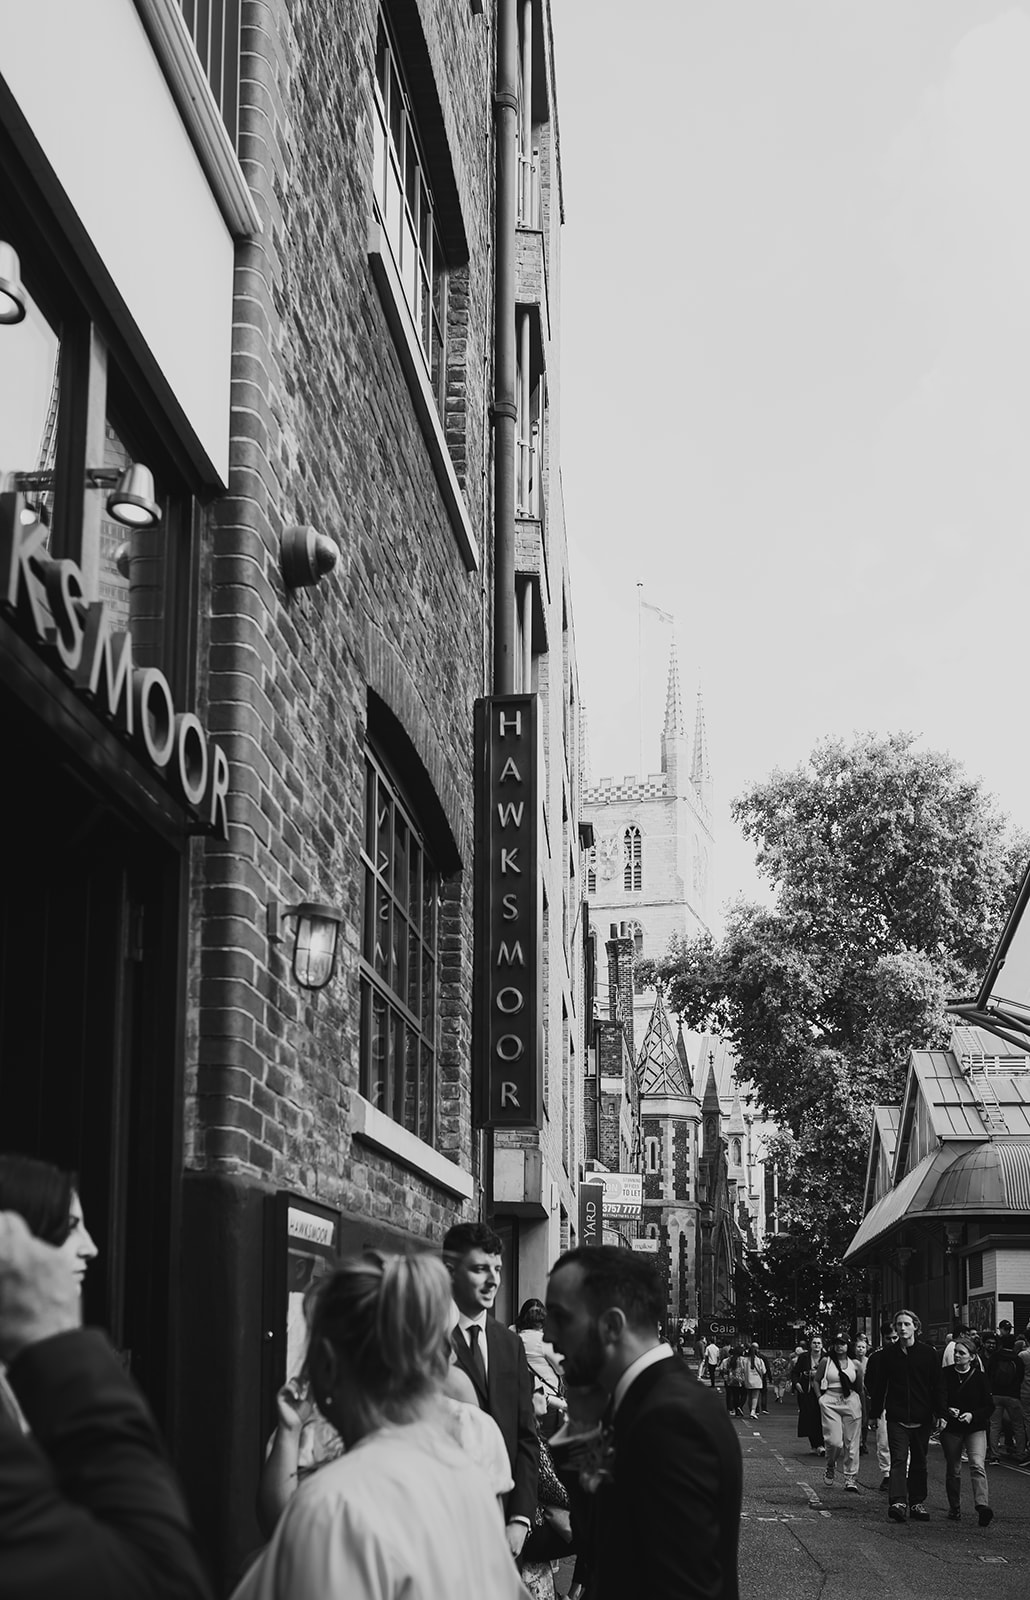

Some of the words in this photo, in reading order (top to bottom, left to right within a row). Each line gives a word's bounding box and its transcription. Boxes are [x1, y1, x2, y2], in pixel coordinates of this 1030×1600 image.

[497, 709, 525, 1109] HAWKSMOOR
[623, 1189, 630, 1197] TO
[602, 1203, 621, 1213] 3757
[622, 1204, 642, 1214] 7777
[583, 1201, 596, 1238] YARD
[709, 1322, 735, 1334] Gaia
